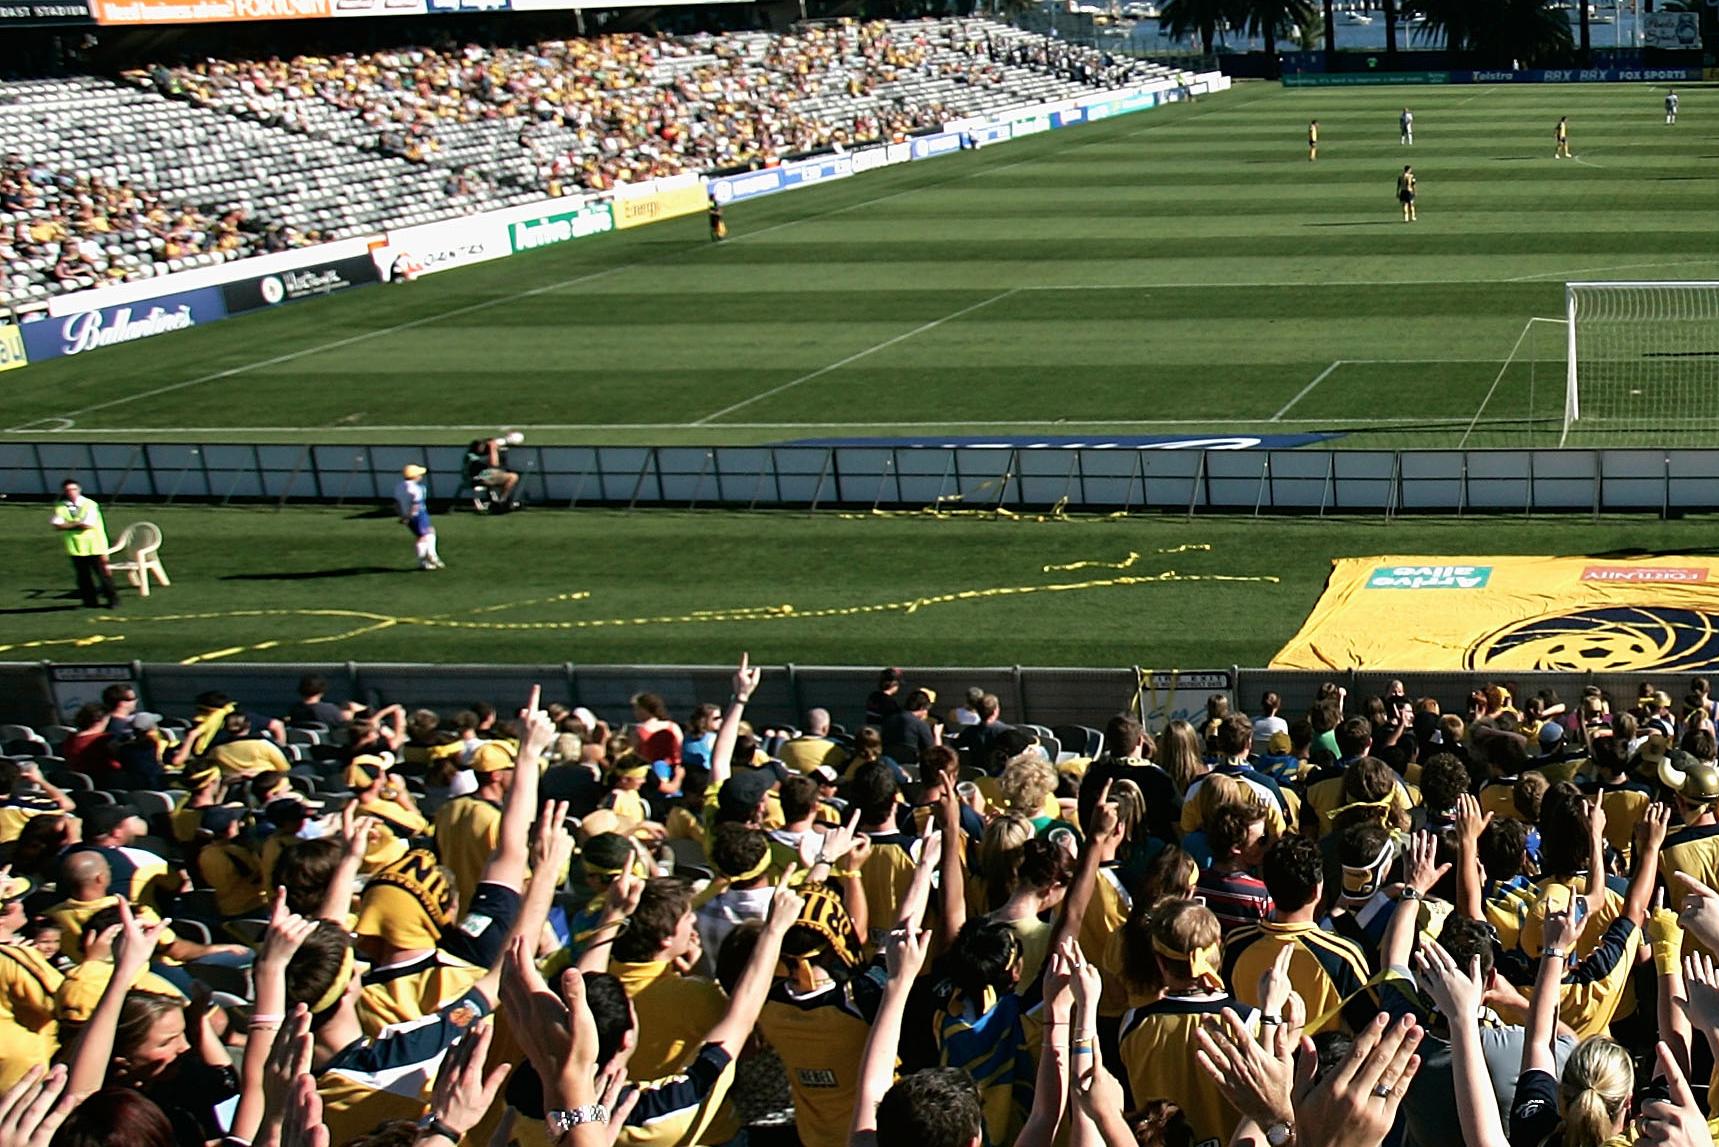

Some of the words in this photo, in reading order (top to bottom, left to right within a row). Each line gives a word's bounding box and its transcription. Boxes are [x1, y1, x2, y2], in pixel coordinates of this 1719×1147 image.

[33, 5, 90, 17] STADIUM
[1472, 71, 1513, 81] Telstra
[1619, 71, 1641, 80] FOX
[1643, 70, 1686, 80] SPORTS
